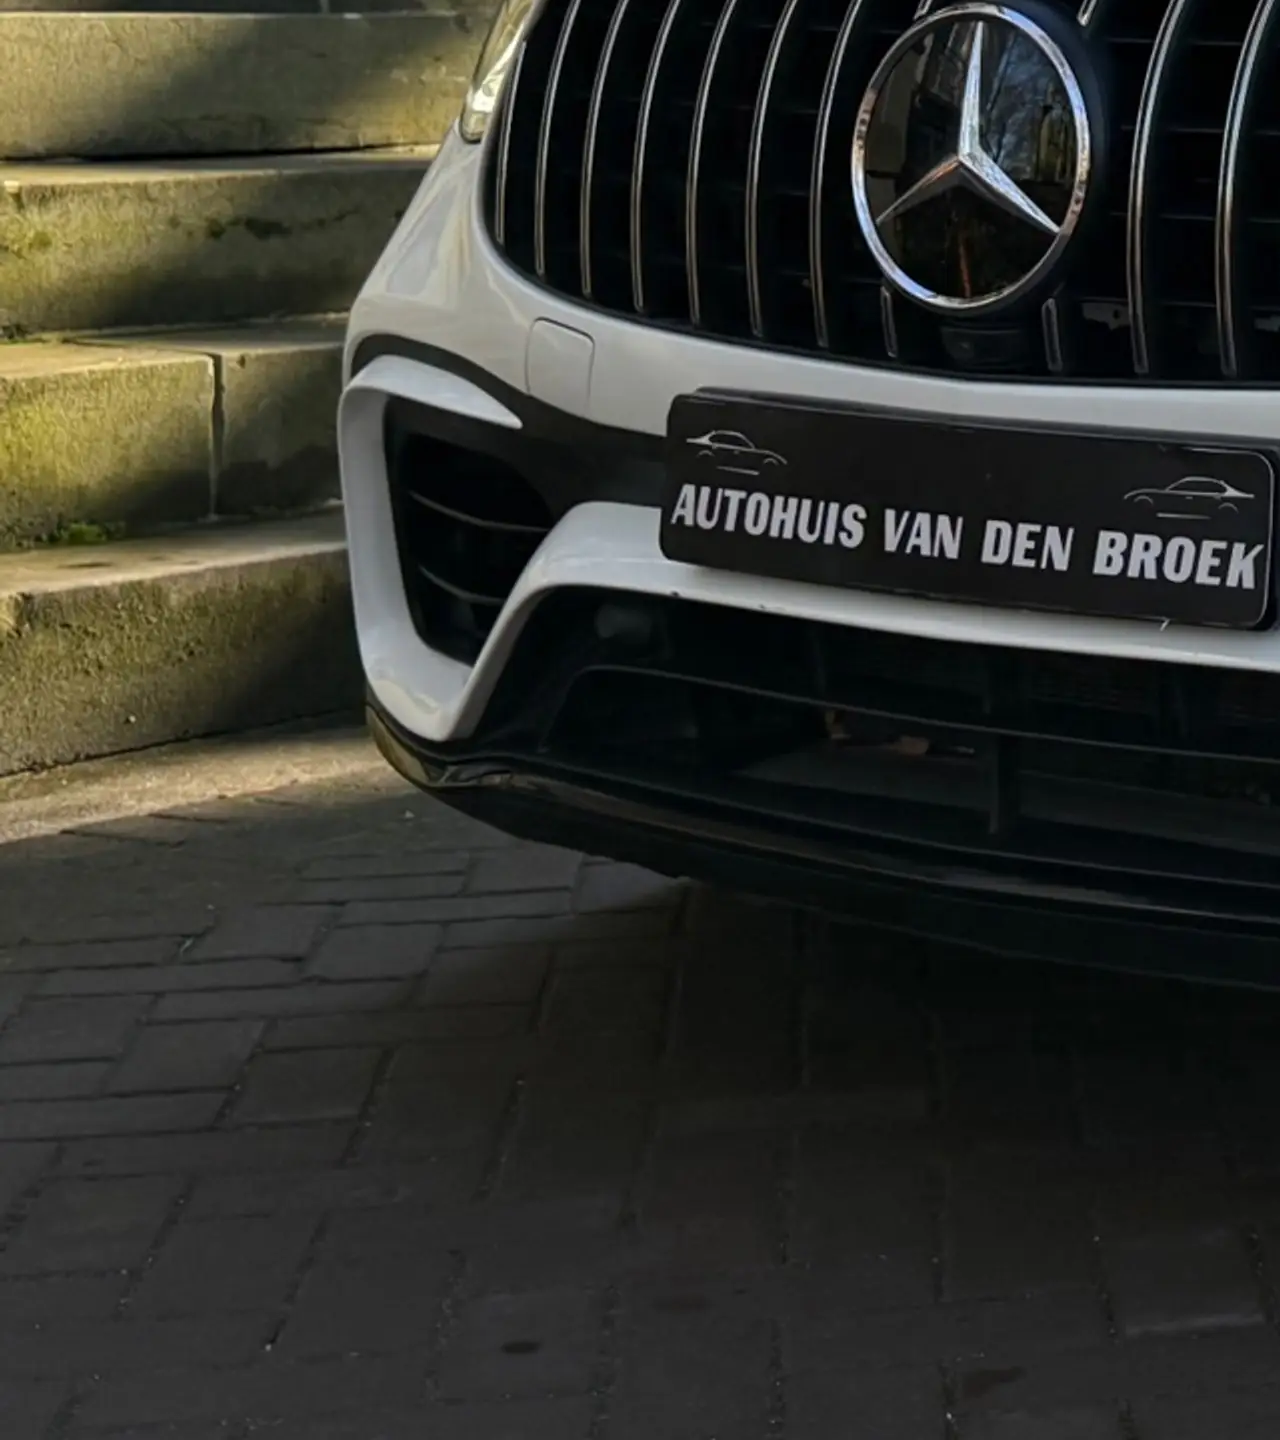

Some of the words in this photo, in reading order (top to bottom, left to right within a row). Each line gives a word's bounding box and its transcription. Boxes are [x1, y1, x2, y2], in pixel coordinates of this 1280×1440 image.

[671, 484, 867, 548] AUTOHUIS
[882, 508, 963, 559] VAN
[981, 519, 1074, 571] DEN
[1093, 530, 1264, 589] BROEK
